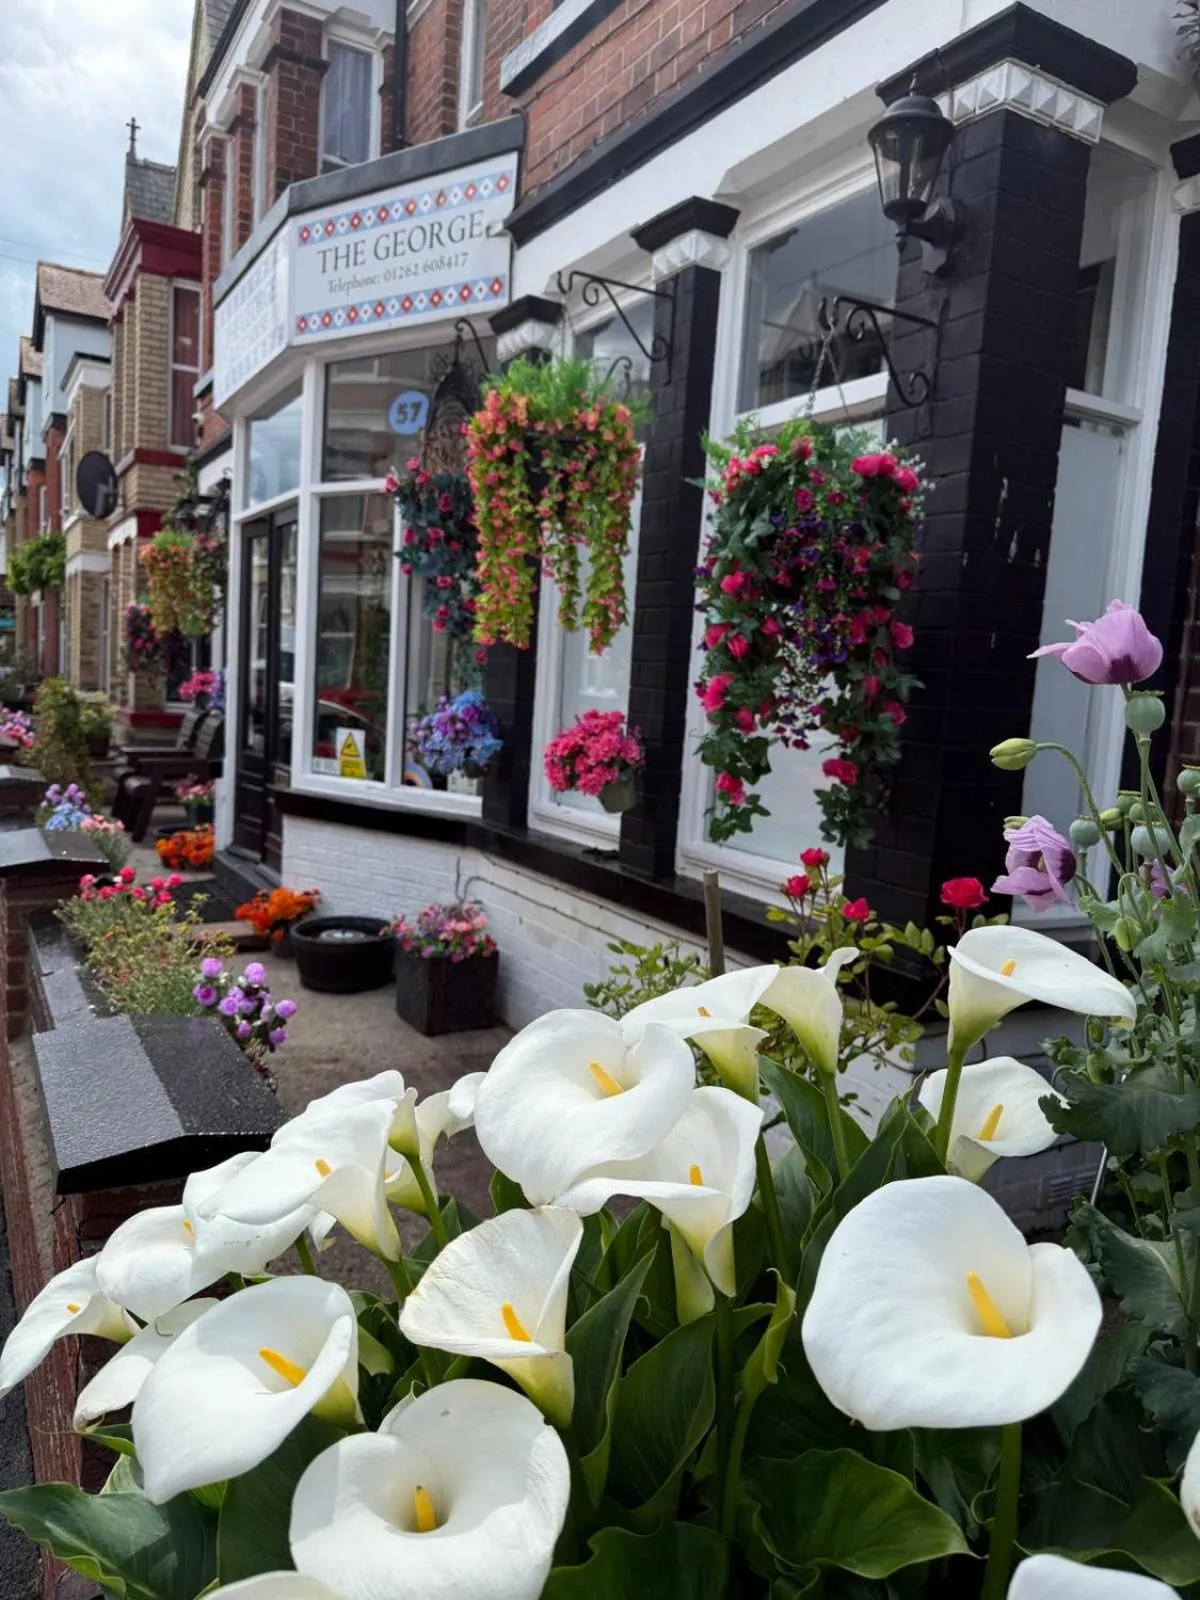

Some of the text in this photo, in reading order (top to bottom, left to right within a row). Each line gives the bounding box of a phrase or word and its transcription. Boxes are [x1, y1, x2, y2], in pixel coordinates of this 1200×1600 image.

[317, 210, 485, 274] THE GEORGE
[328, 252, 469, 296] Telephone: 01262 608417
[397, 401, 422, 424] 57
